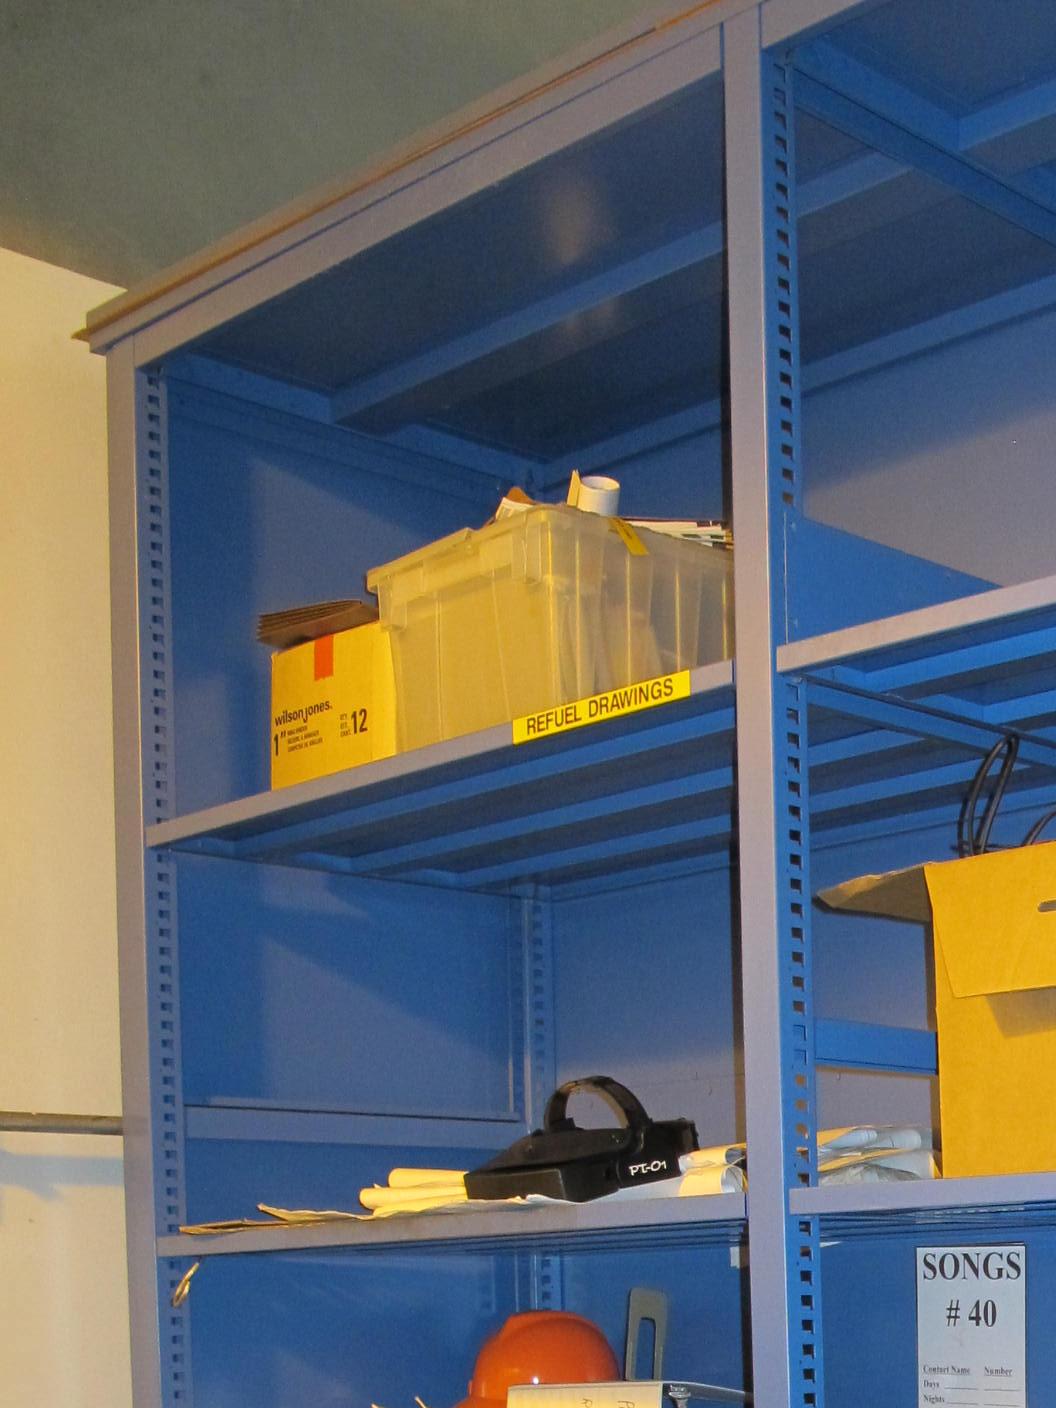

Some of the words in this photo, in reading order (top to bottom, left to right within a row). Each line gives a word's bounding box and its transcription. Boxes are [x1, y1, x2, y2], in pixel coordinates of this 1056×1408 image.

[527, 704, 582, 736] REFUEL
[588, 677, 674, 718] DRAWINGS
[351, 708, 369, 735] 12
[922, 1251, 1022, 1281] SONGS
[946, 1299, 961, 1327] #
[967, 1299, 997, 1328] 40
[922, 1364, 949, 1375] Contact
[951, 1365, 971, 1375] Name
[984, 1366, 1013, 1376] Number
[923, 1379, 940, 1389] Days
[923, 1394, 945, 1404] Nights
